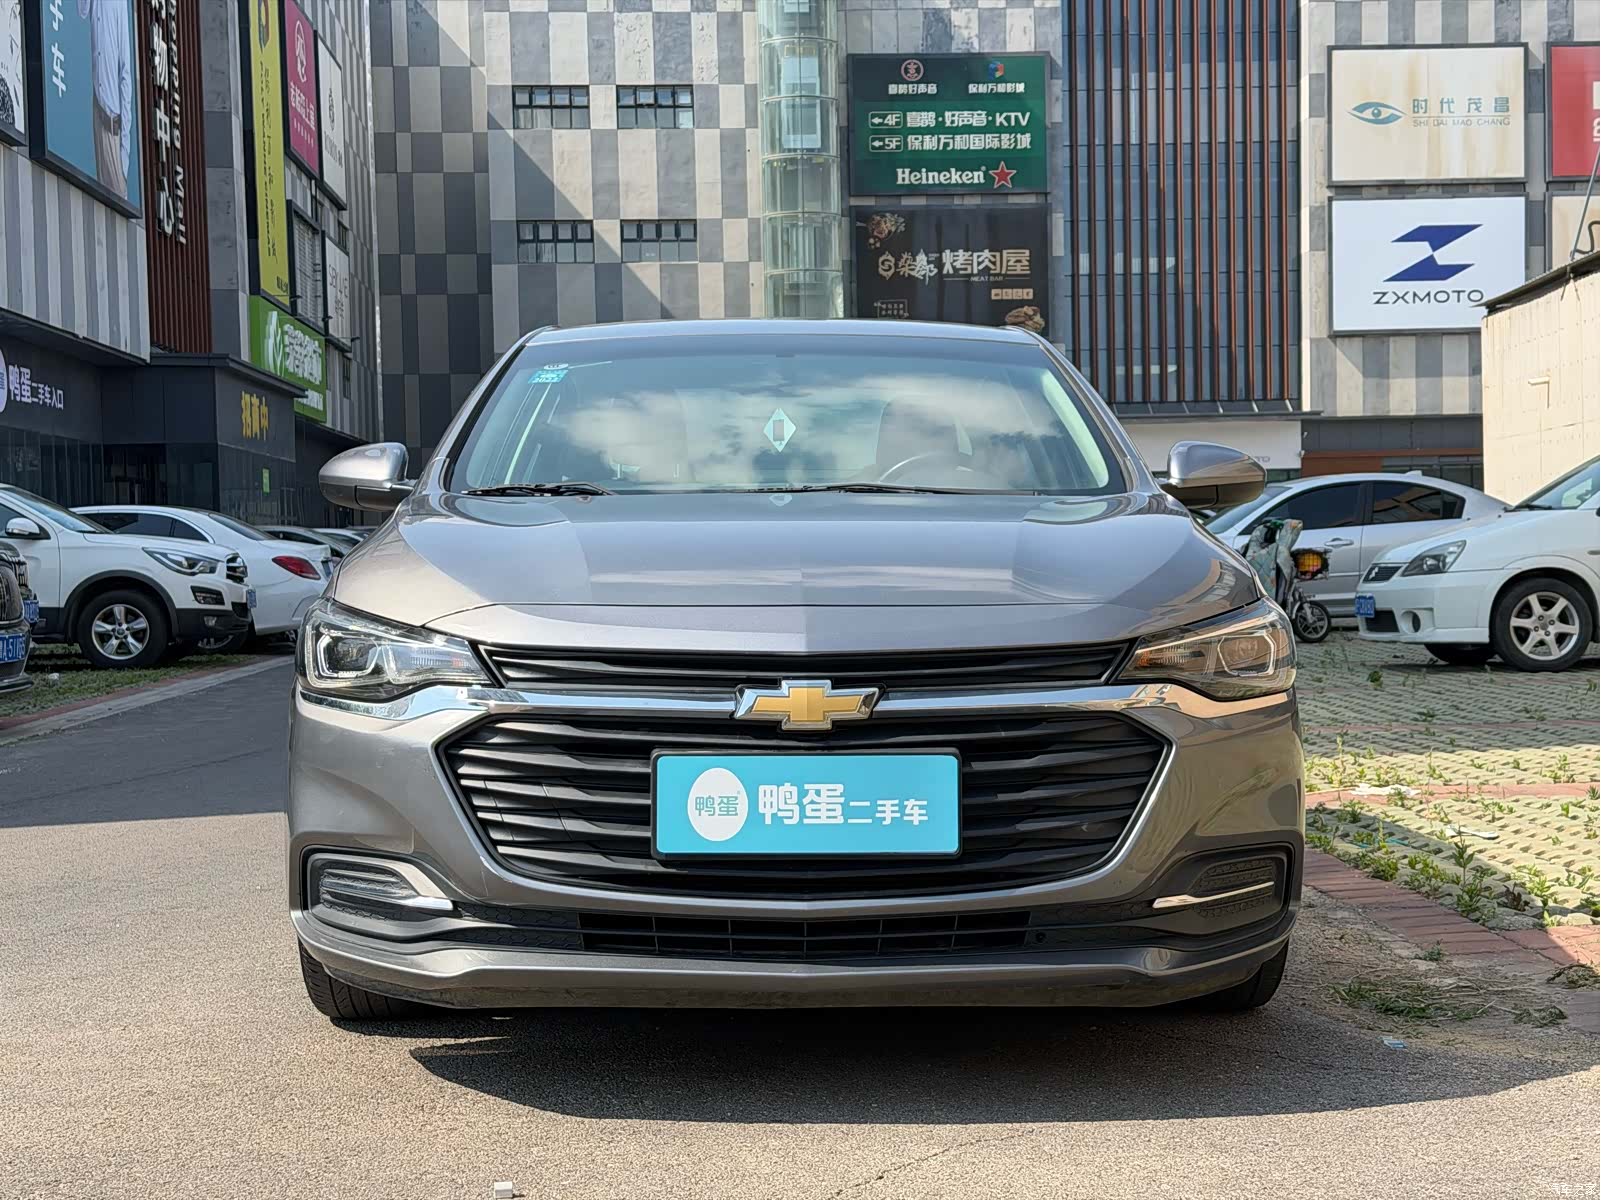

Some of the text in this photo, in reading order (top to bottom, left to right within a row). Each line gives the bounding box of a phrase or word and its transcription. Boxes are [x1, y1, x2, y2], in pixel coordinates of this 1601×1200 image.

[968, 82, 1026, 94] 保利万和影城
[1412, 97, 1510, 114] 时代茂昌
[151, 0, 175, 236] 物中心
[884, 113, 900, 126] 4F
[1476, 117, 1511, 127] CHANG
[884, 133, 1032, 151] 5F 保利万和国际影城
[896, 168, 986, 185] Heineken
[942, 249, 1031, 275] 烤肉屋
[1372, 289, 1485, 305] ZXMOTO
[694, 782, 929, 826] 鸭蛋 鸭蛋二手车
